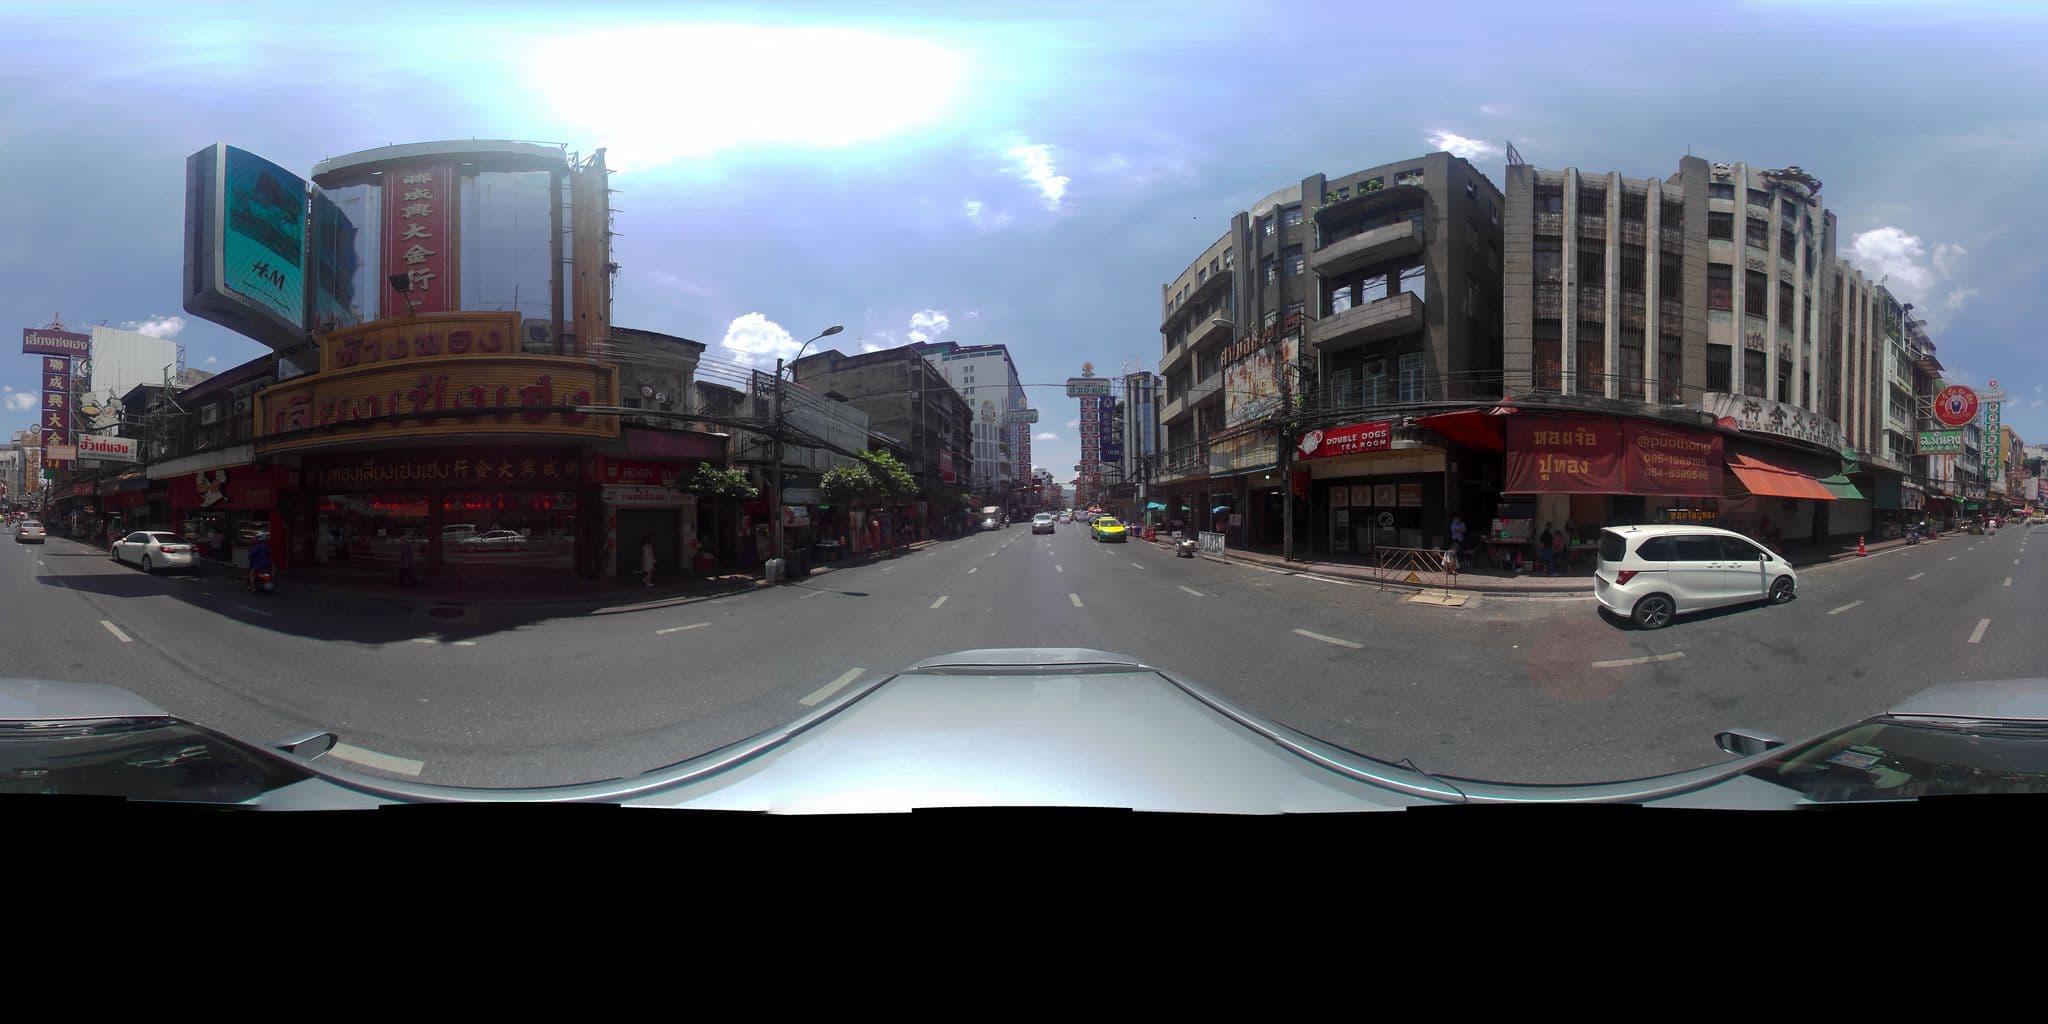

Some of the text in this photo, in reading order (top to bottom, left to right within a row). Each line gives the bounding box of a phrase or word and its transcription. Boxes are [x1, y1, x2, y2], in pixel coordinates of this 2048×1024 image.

[251, 259, 286, 291] H&M
[1326, 430, 1387, 445] DOUBLE DOGS
[1360, 439, 1387, 448] ROOM
[1637, 435, 1712, 455] @puothong
[1538, 454, 1589, 481] ปูทอง
